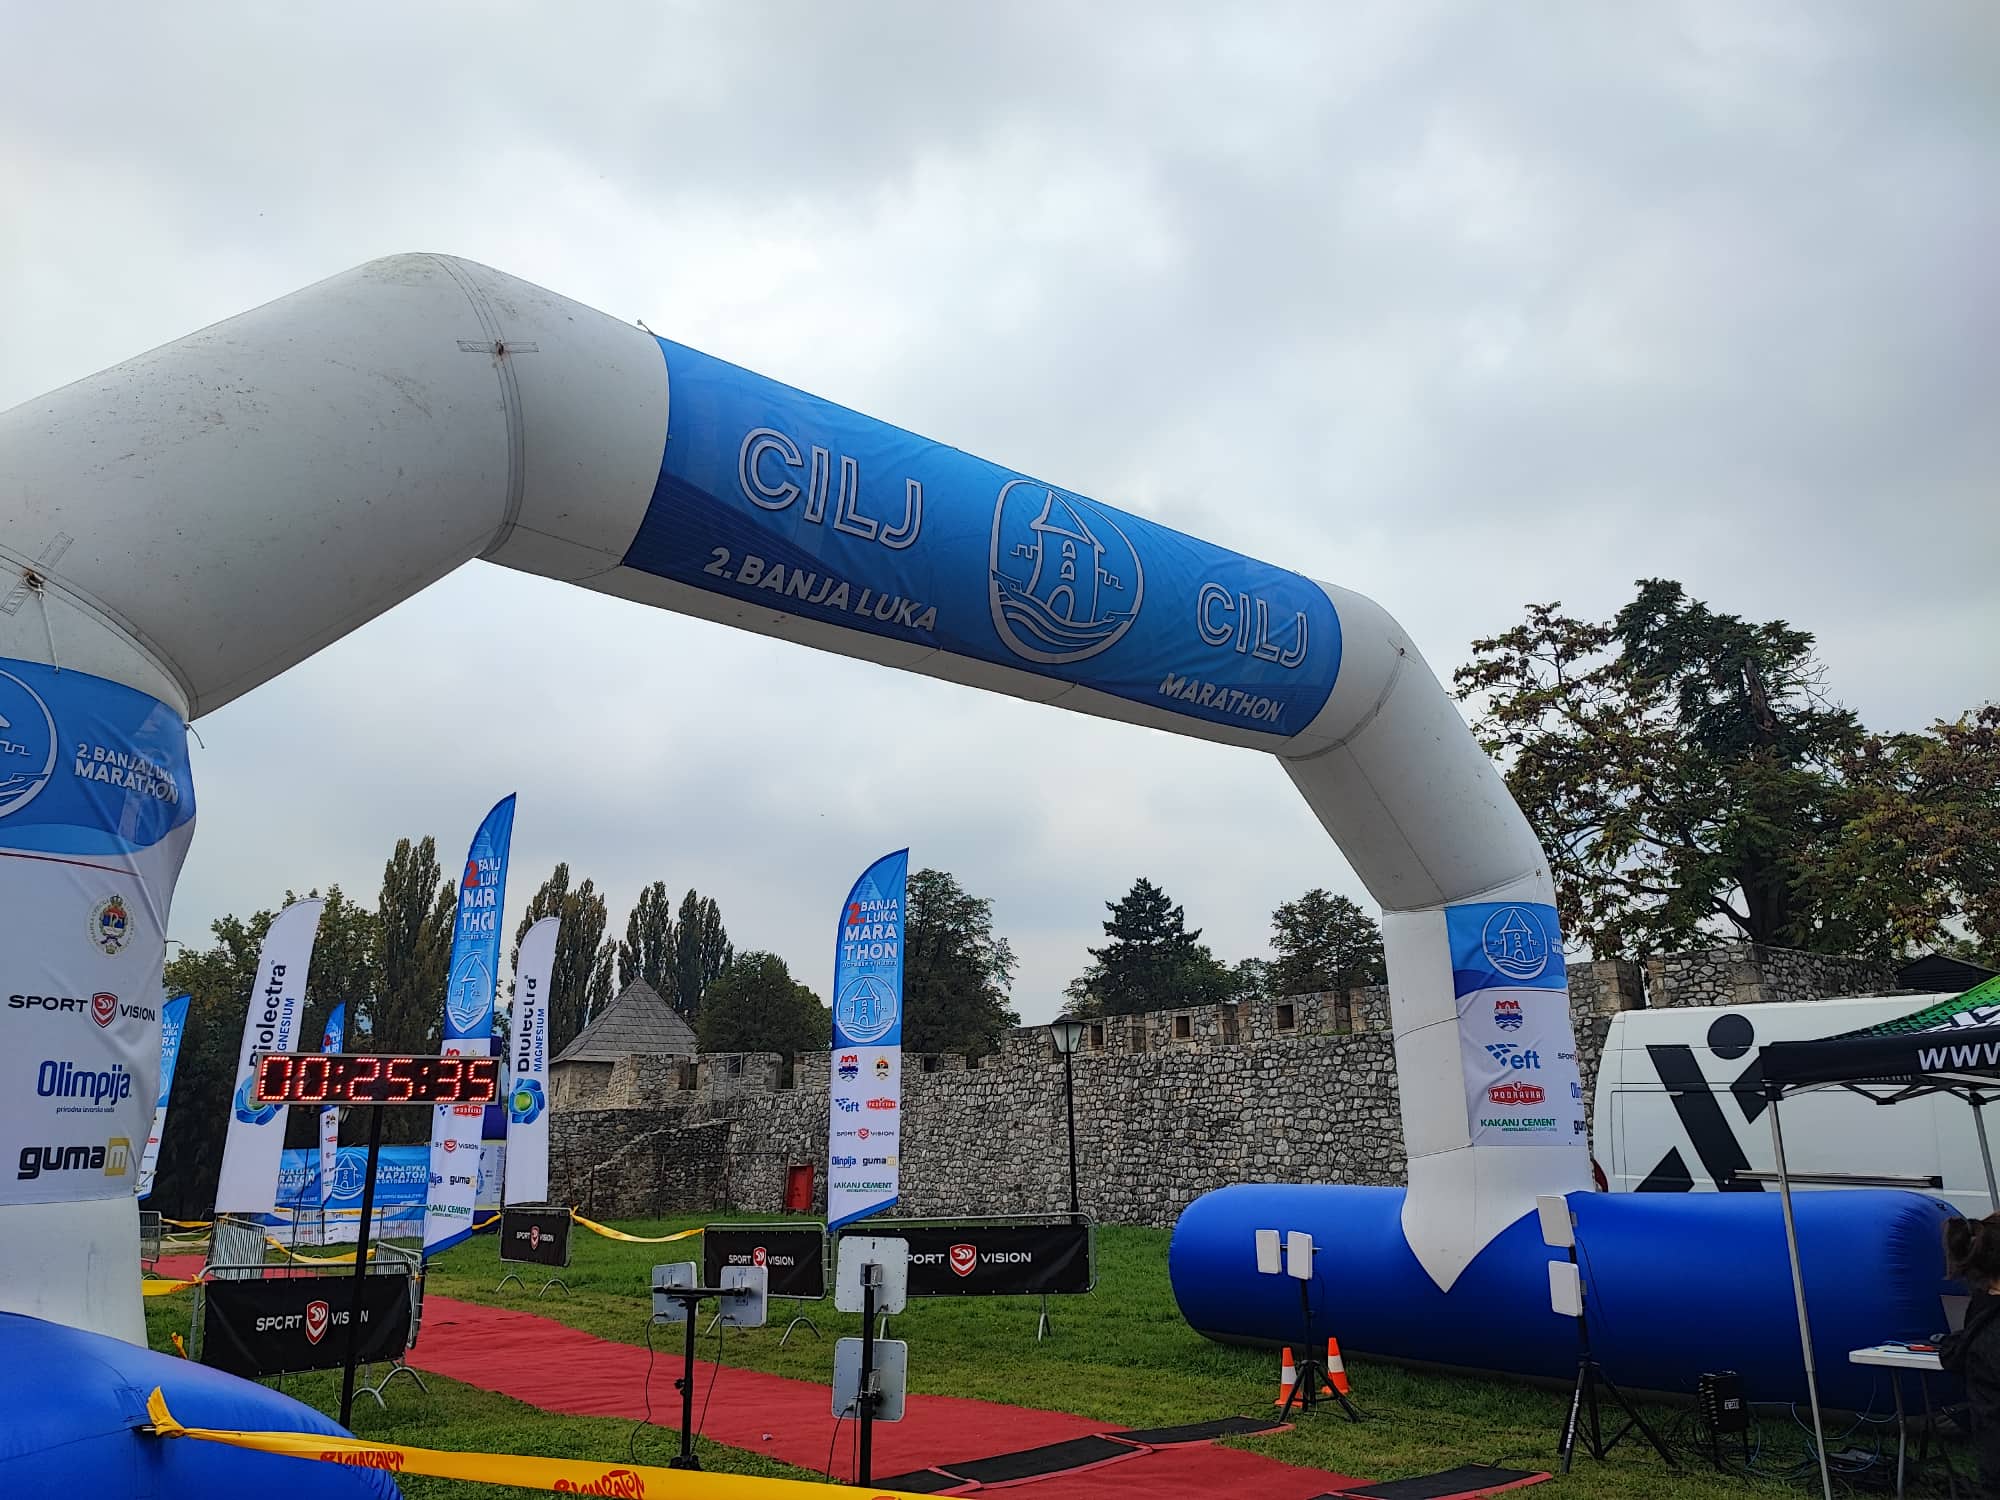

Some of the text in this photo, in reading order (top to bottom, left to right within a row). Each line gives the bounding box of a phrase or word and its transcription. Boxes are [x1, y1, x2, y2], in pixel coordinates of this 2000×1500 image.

[738, 427, 924, 549] CILJ
[703, 547, 938, 631] 2. BANJA LUKA
[1197, 582, 1308, 668] CILJ
[1158, 672, 1285, 722] MARATHON
[77, 743, 91, 759] 2.
[74, 758, 179, 804] MARATHON
[860, 898, 898, 912] BANJA
[866, 910, 898, 923] LUKA
[845, 923, 897, 941] MARA
[843, 942, 898, 961] THON
[8, 994, 156, 1022] SPORT VISION
[277, 998, 296, 1052] GNESIUM
[534, 1008, 545, 1072] MAGNESIUM
[1510, 1049, 1541, 1070] eft
[37, 1060, 131, 1105] Olimpija
[259, 1055, 494, 1102] 00:25:35
[1480, 1118, 1557, 1127] KAKANJ CEMENT
[728, 1254, 794, 1266] SPORT VISION
[980, 1252, 1032, 1263] VISION
[256, 1310, 369, 1332] SPORT VISN
